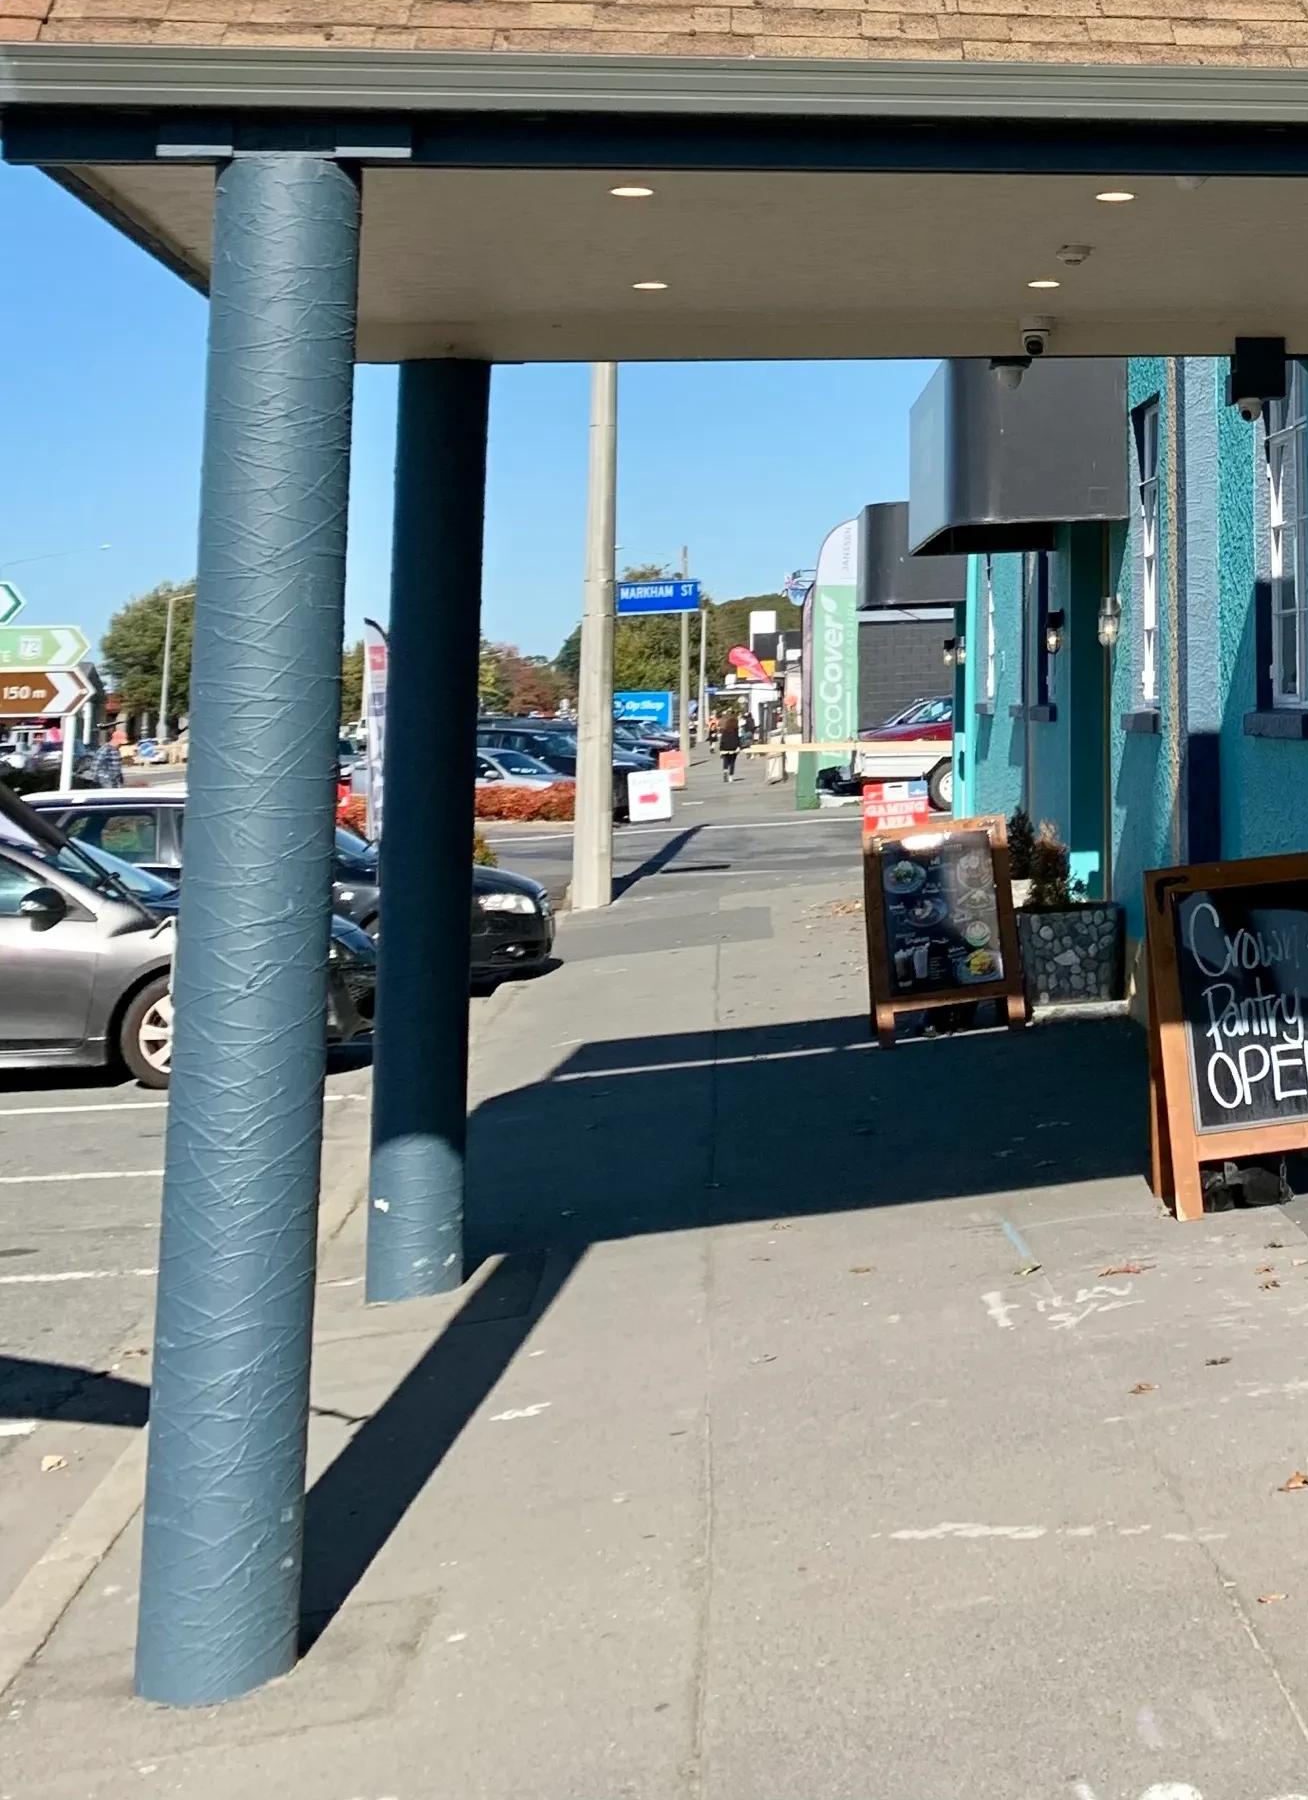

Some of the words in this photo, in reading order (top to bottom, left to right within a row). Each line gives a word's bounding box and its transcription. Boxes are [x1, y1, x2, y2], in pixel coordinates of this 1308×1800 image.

[620, 585, 674, 600] MARKHAM
[680, 583, 694, 597] ST
[3, 685, 31, 700] 150
[32, 688, 48, 699] m
[865, 800, 926, 817] GAMING
[876, 814, 916, 830] AREA
[1189, 902, 1300, 977] Crown
[1202, 977, 1305, 1050] Pantry
